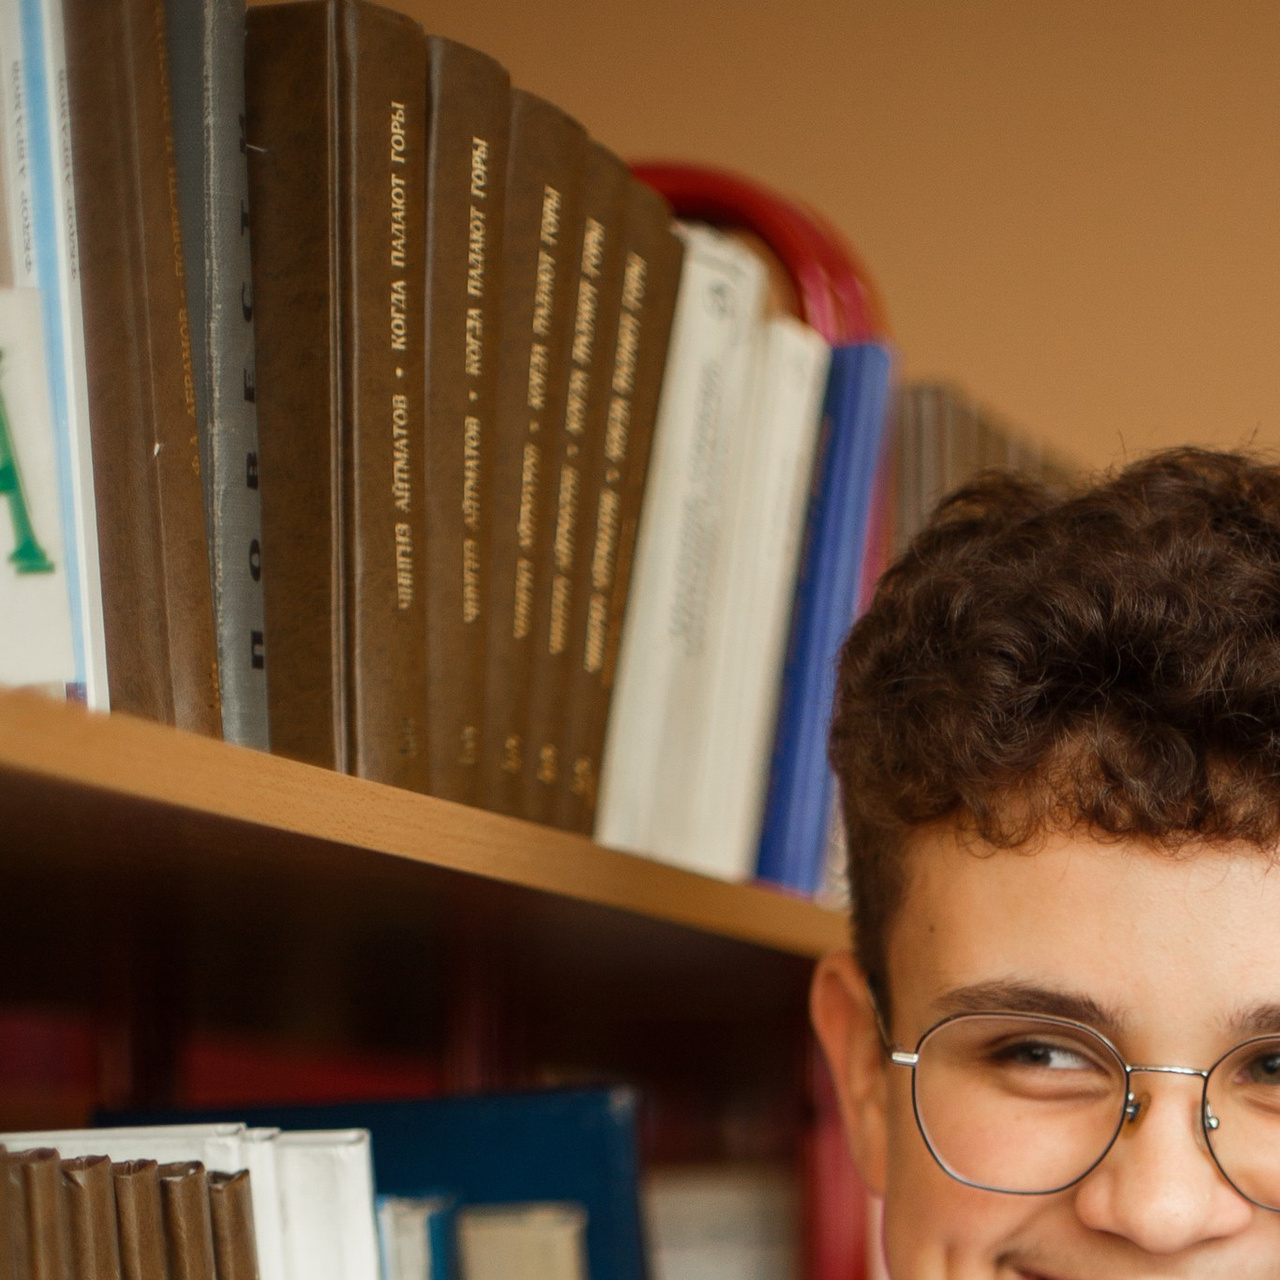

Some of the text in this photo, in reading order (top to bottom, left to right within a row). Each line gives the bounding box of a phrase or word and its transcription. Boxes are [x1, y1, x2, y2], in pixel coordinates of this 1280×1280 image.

[471, 136, 489, 198] ГОРЫ
[467, 205, 487, 298] ПАДАЮТ
[391, 101, 413, 610] ЧИНГИЗ АЙТМАТОВ КОГДА ПАДАЮТ ГОРЫ
[465, 308, 483, 376] КОГДА
